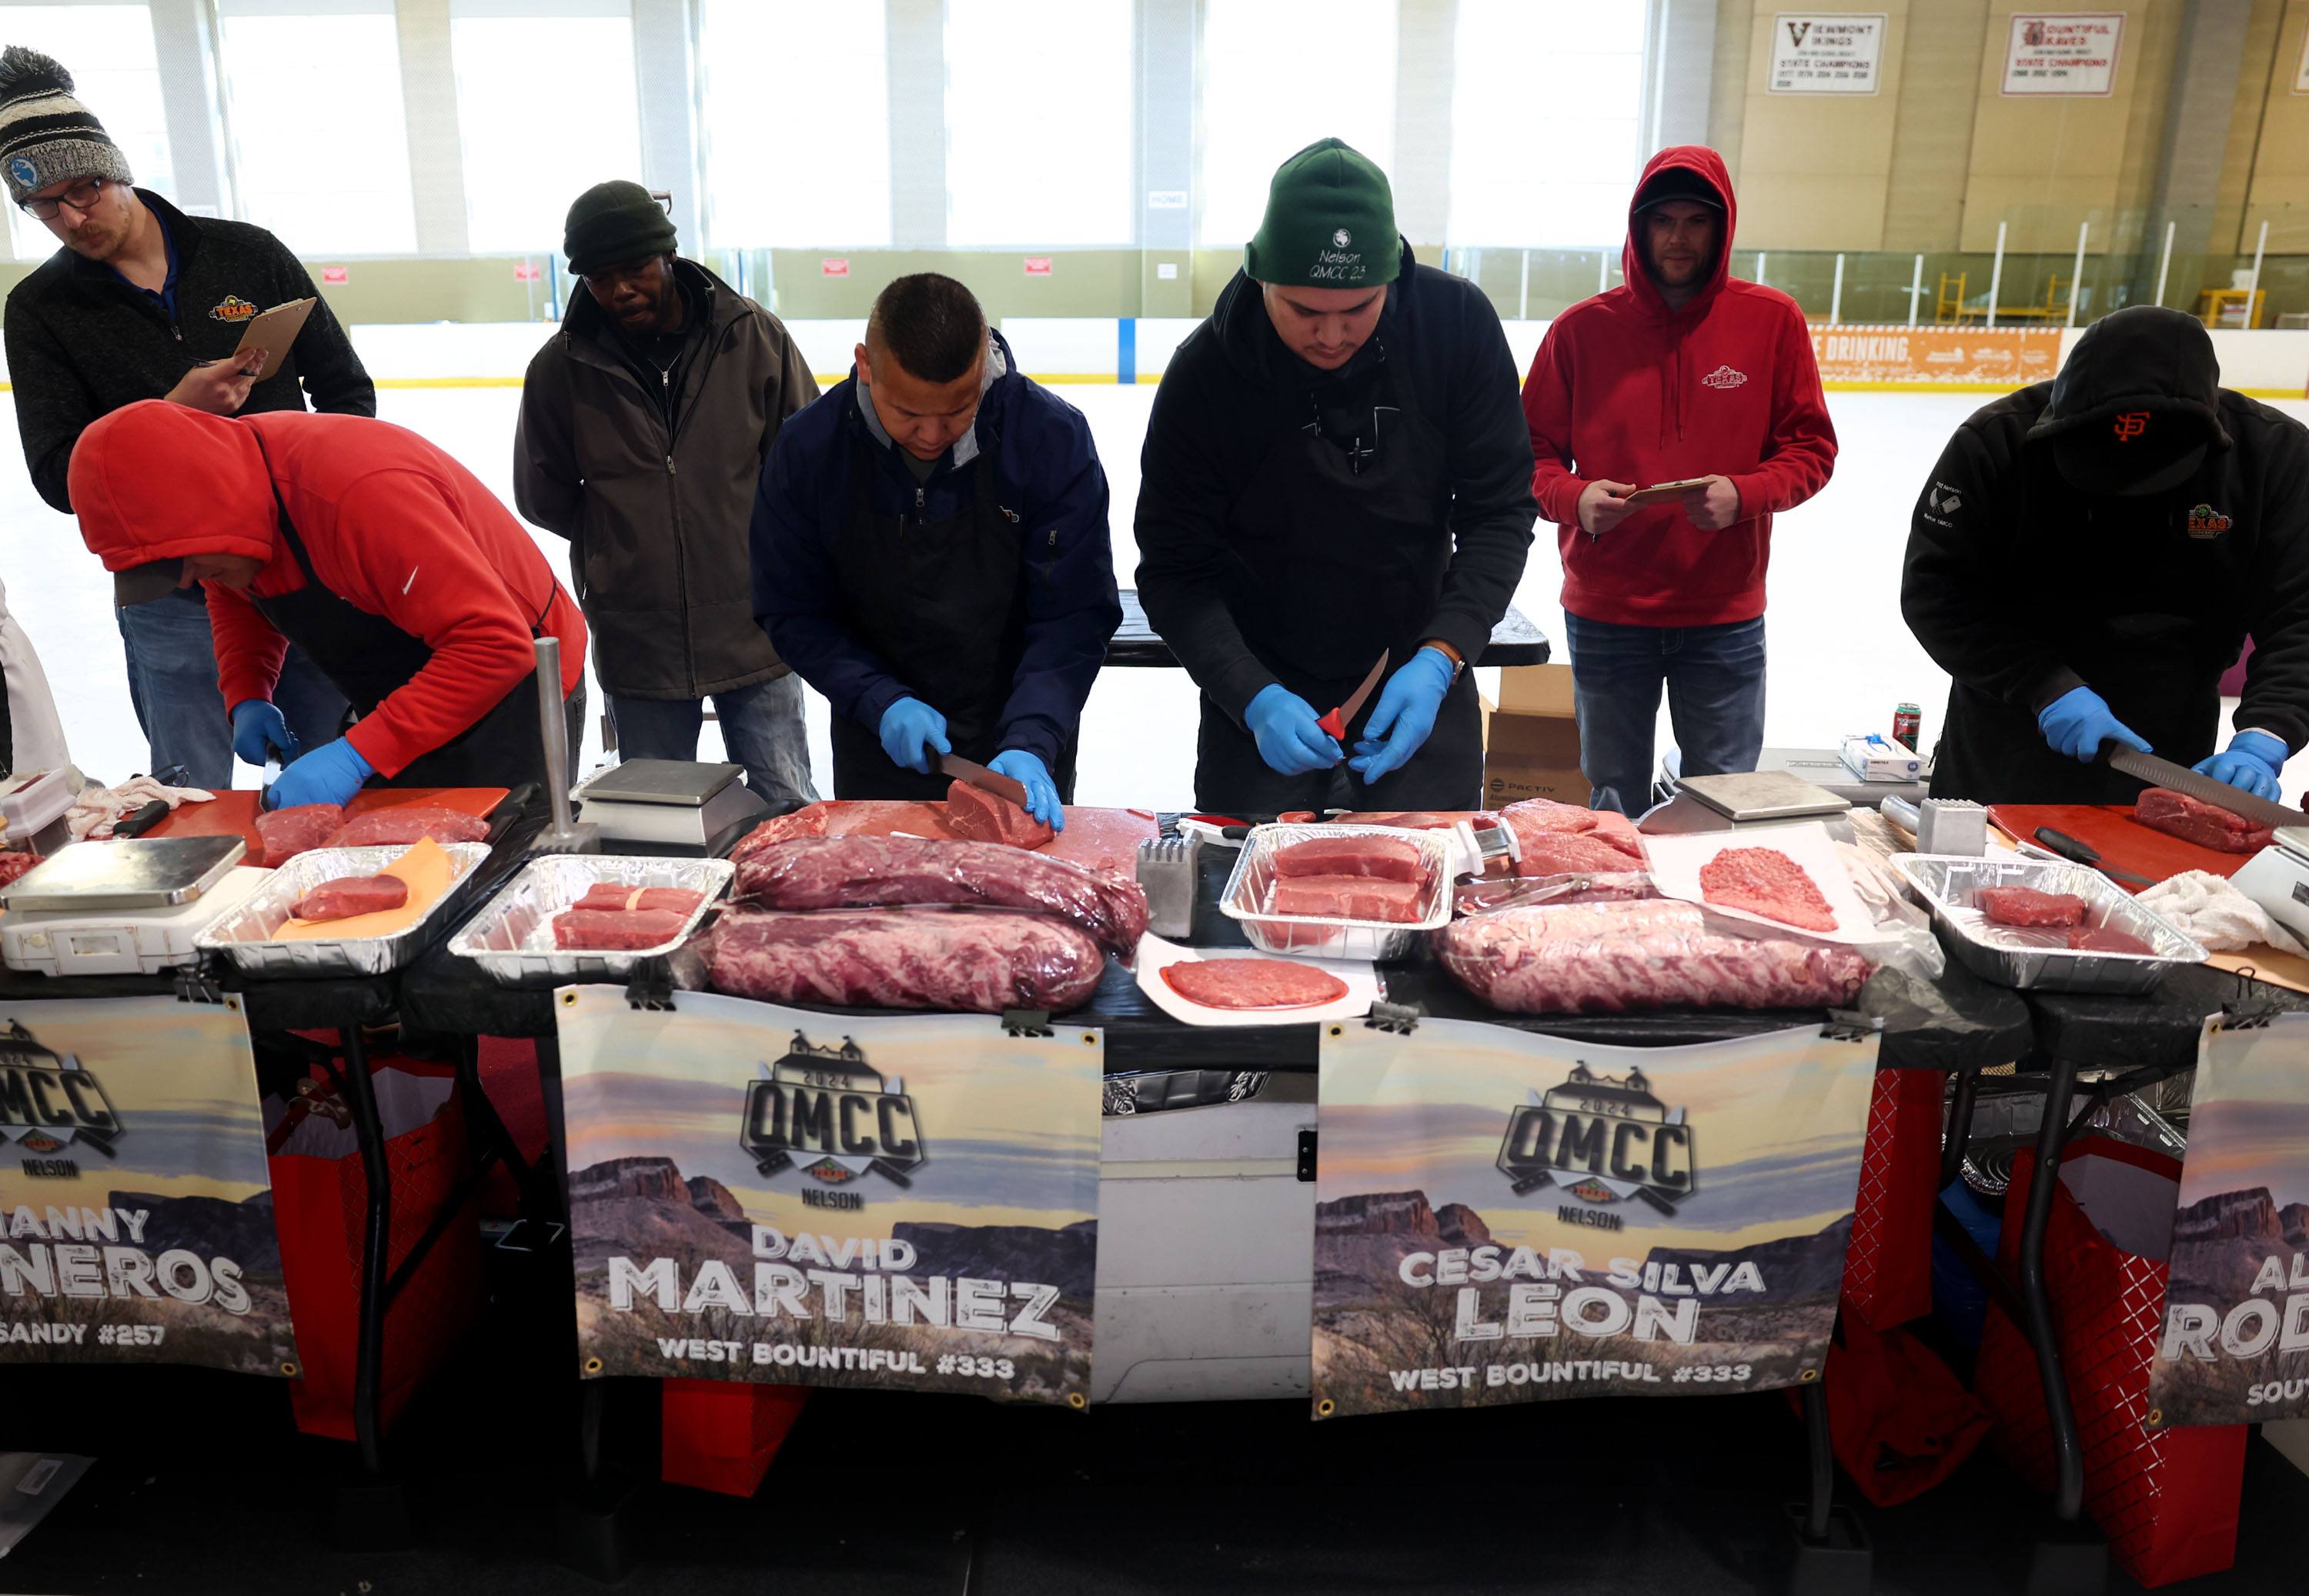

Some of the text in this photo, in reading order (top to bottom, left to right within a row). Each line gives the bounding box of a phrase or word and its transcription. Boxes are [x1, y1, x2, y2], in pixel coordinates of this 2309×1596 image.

[1318, 249, 1361, 263] Nelson
[1309, 265, 1366, 279] QMCC 23
[216, 304, 254, 317] TEXAS
[1708, 375, 1742, 384] TEXAS
[1509, 783, 1556, 793] PACTIV
[803, 1070, 850, 1088] 2024
[1579, 1097, 1630, 1115] 2024
[749, 1083, 917, 1155] QMCC
[1507, 1110, 1687, 1185] QMCC
[22, 1158, 78, 1177] NELSON
[801, 1187, 860, 1210] NELSON
[1557, 1204, 1620, 1230] NELSON
[751, 1224, 917, 1271] DAVID
[1398, 1245, 1766, 1294] CESAR SILVA
[608, 1256, 1061, 1341] MARTINEZ
[1455, 1282, 1702, 1345] LEON
[98, 1324, 166, 1346] #257
[657, 1337, 1015, 1380] WEST BOUNTIFUL #333
[1389, 1360, 1753, 1392] WEST BOUNTIFUL #333
[2246, 1378, 2309, 1406] SOU
